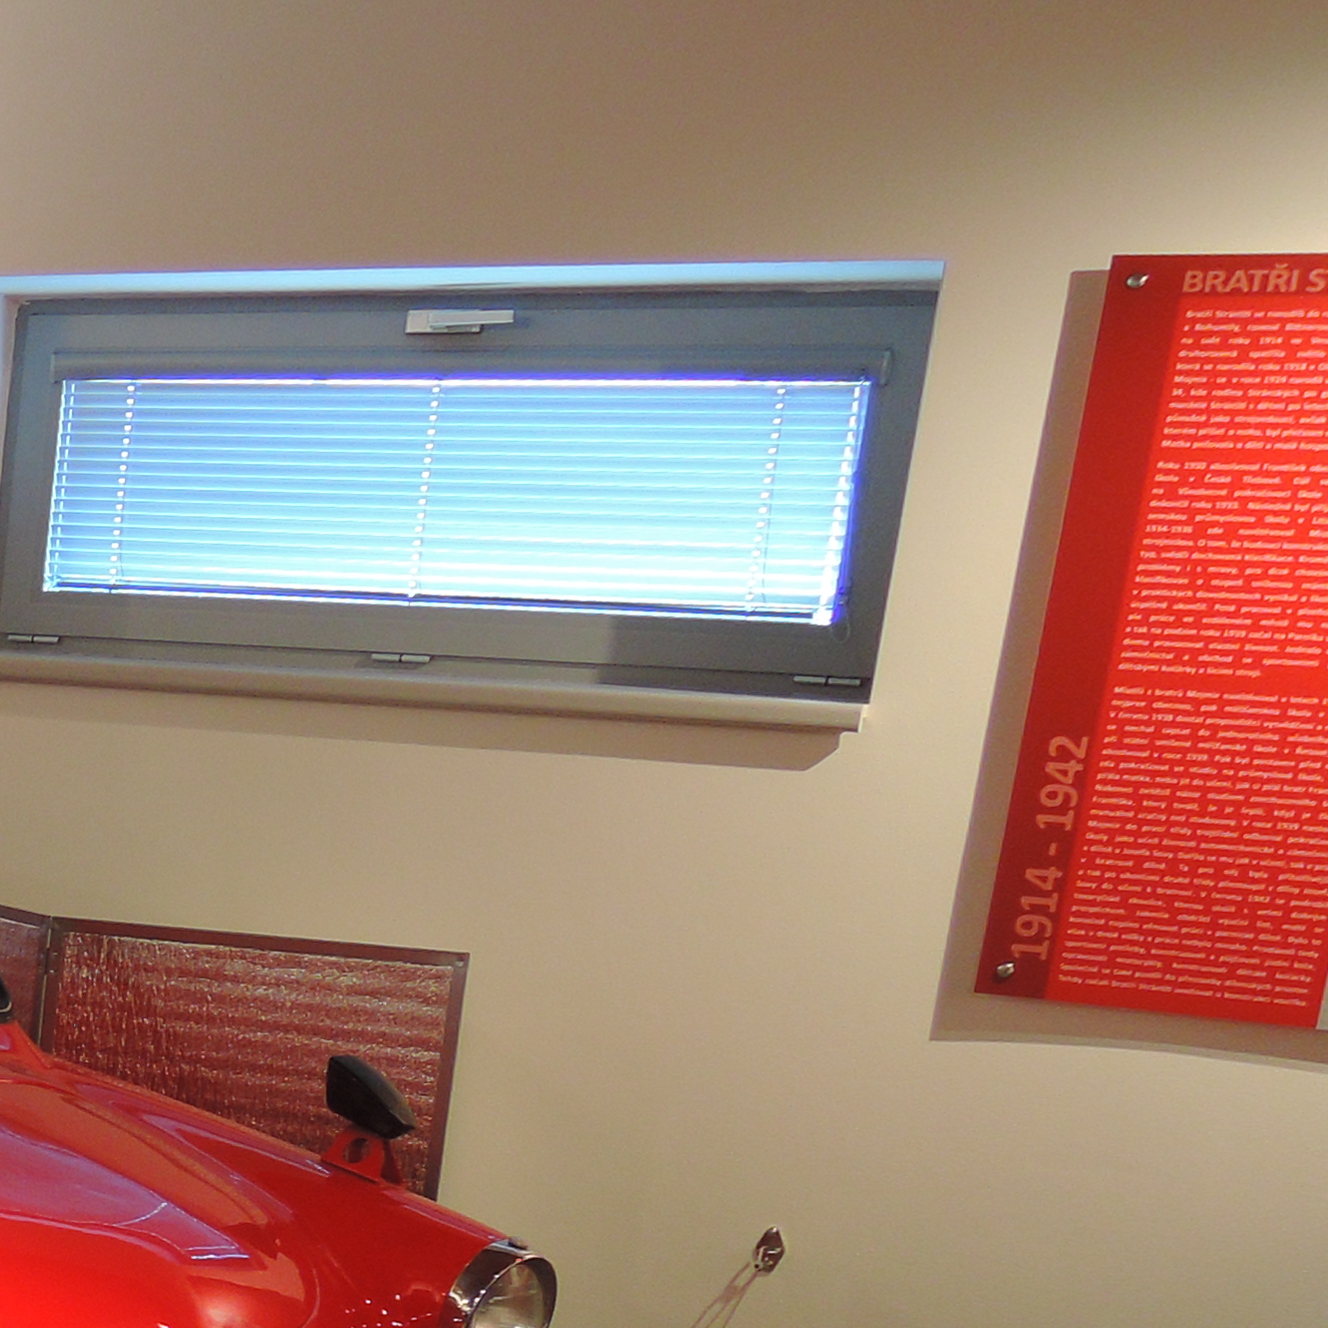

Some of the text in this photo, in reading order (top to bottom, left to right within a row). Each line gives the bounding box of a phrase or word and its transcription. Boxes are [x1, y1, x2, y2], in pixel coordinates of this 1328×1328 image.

[1182, 262, 1328, 293] BRATŘI S
[1035, 735, 1090, 832] 1942
[1011, 865, 1063, 961] 1914
